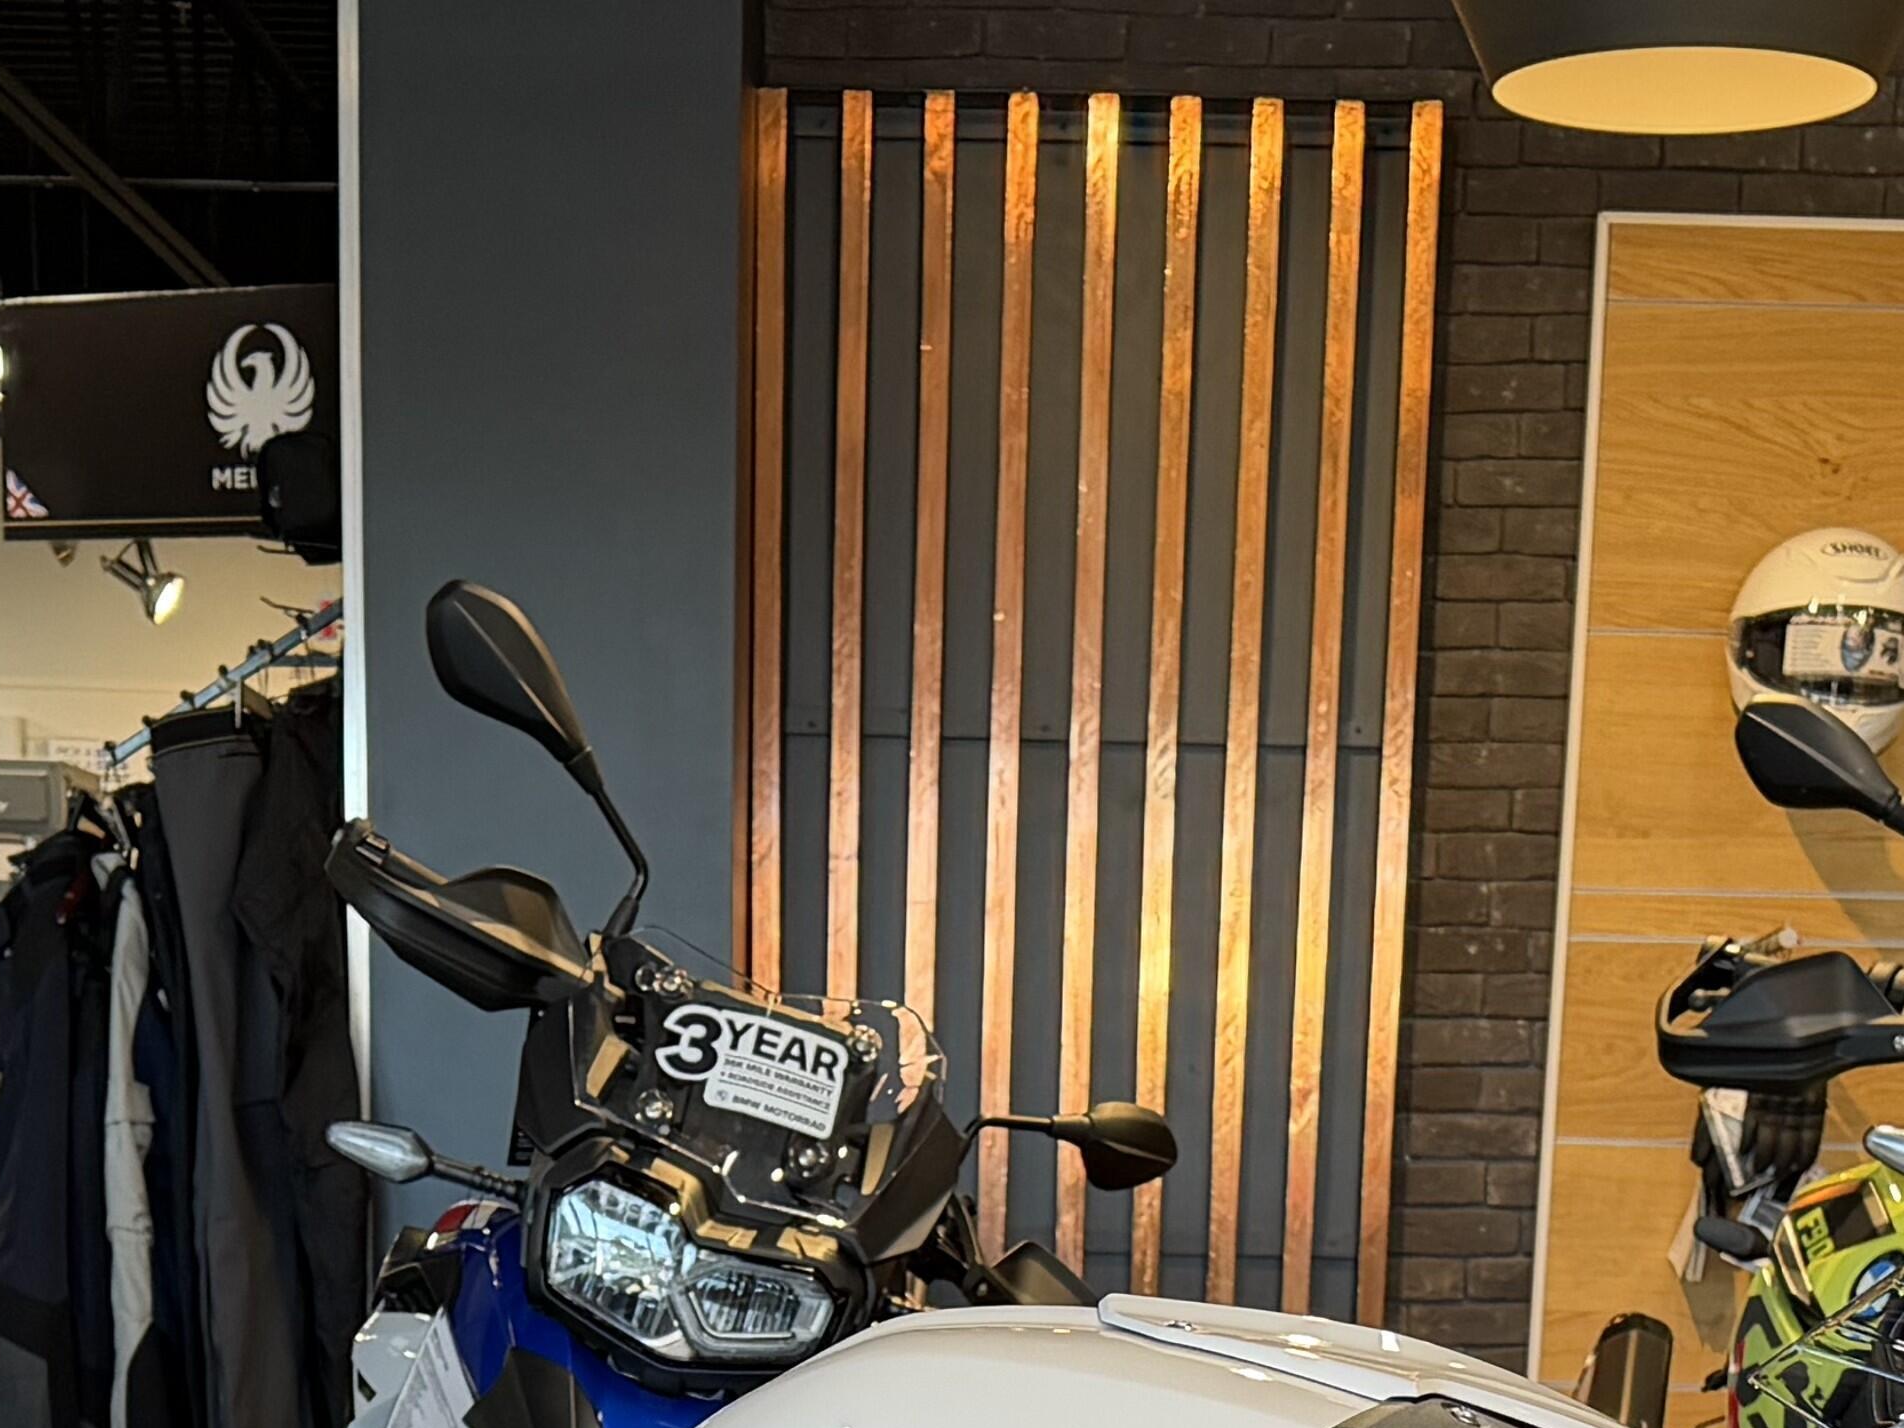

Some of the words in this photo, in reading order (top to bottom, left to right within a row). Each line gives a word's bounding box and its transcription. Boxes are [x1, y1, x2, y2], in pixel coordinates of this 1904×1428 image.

[664, 1012, 723, 1075] 3
[725, 1017, 839, 1083] YEAR
[746, 1063, 771, 1077] MILE
[773, 1068, 834, 1098] WARRANTY
[732, 1095, 761, 1110] BMW
[763, 1103, 827, 1133] MOTORRAD
